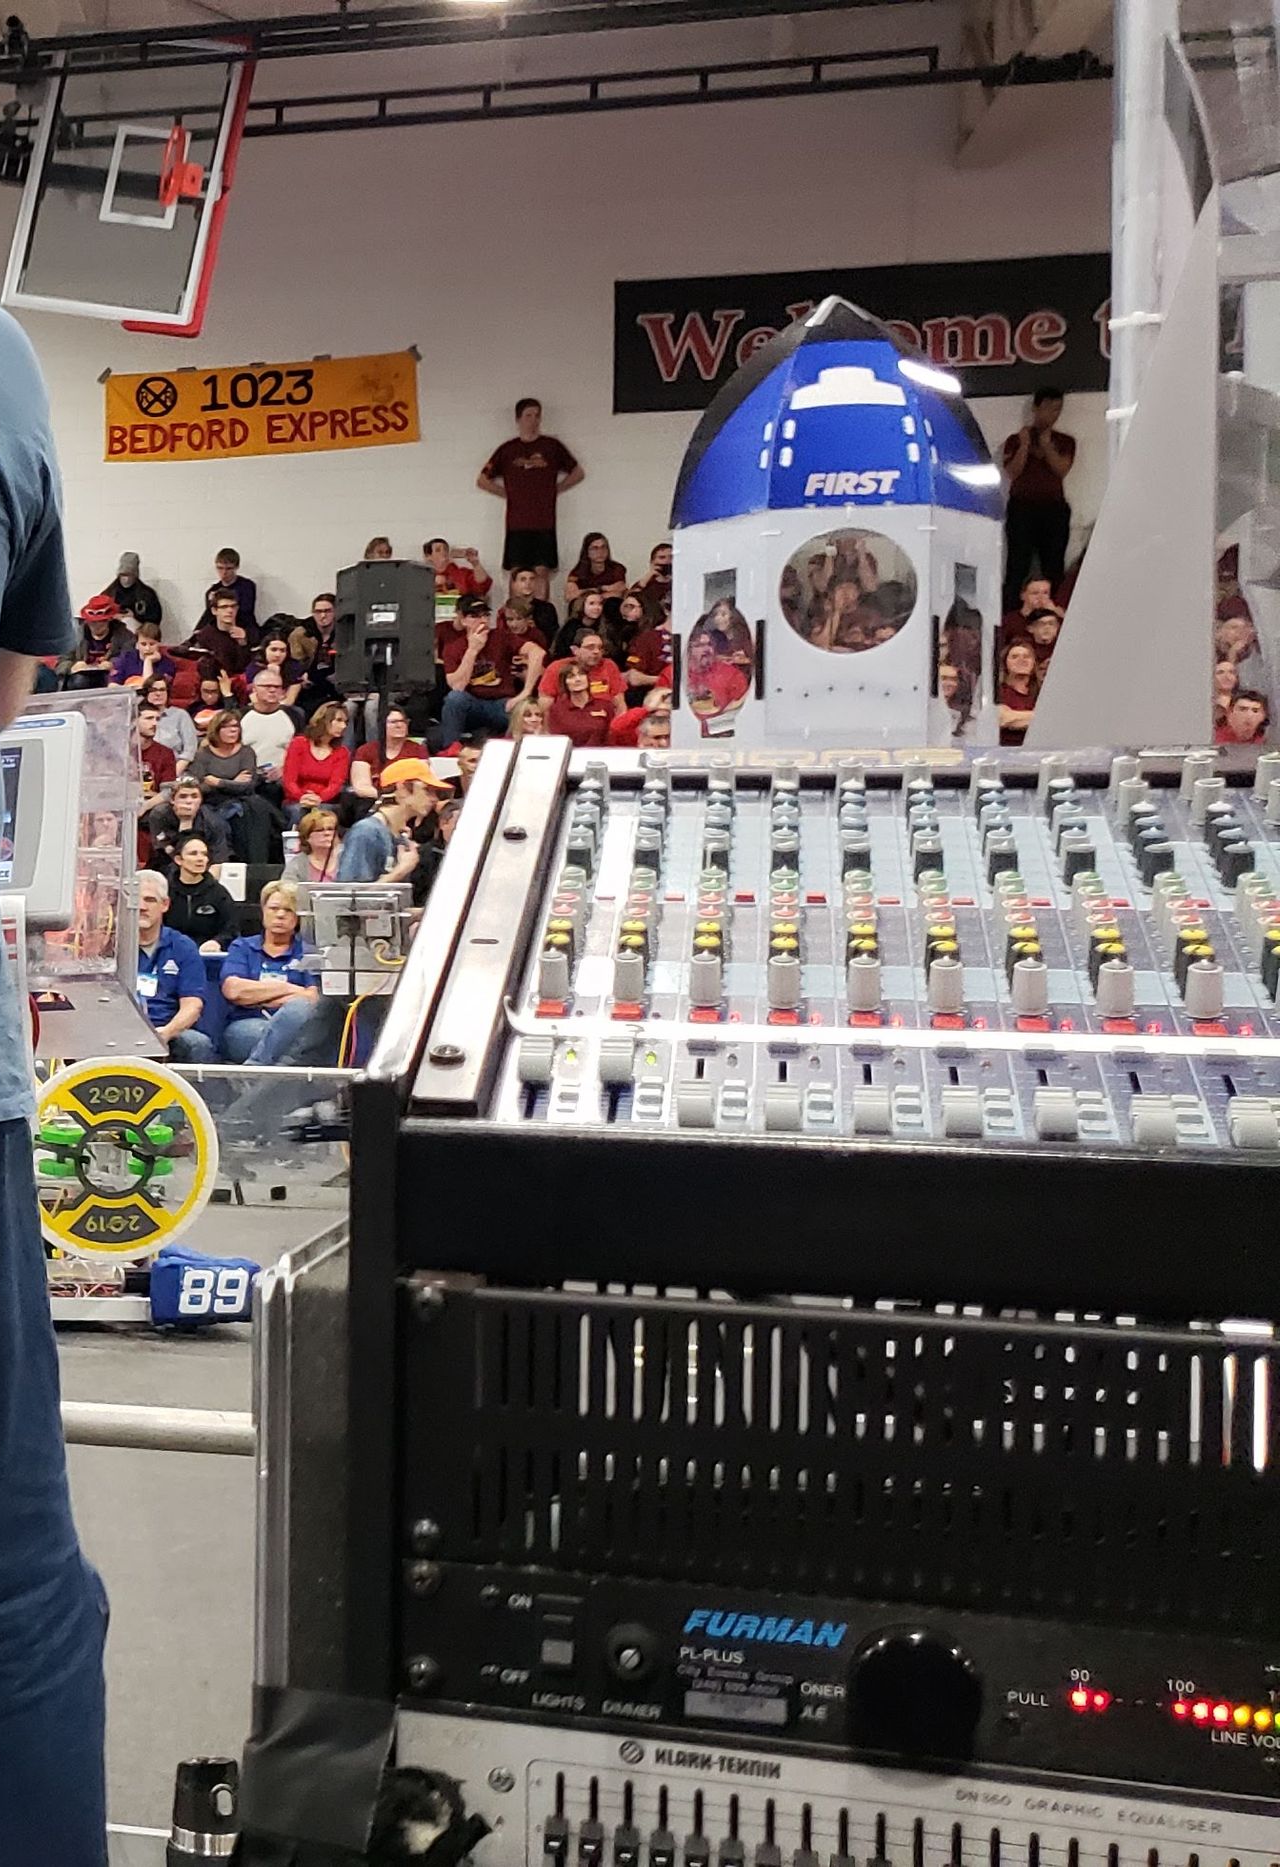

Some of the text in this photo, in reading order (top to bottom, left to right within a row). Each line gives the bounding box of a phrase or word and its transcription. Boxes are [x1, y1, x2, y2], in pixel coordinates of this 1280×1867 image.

[201, 369, 314, 411] 1023
[107, 401, 410, 455] BEDFORD EXPRESS
[804, 470, 901, 496] FIRST
[88, 1086, 146, 1105] 2019
[177, 1268, 250, 1315] 89
[507, 1592, 533, 1611] ON
[682, 1607, 848, 1649] FURMAN
[679, 1646, 745, 1665] PL-PLUS
[1069, 1668, 1196, 1694] 90 100
[531, 1691, 663, 1720] LIGHTS DIMMER
[1006, 1690, 1050, 1708] PULL
[1210, 1729, 1249, 1746] LINE
[1024, 1797, 1105, 1820] GRAPHIC
[1116, 1810, 1225, 1835] EQUALISER
